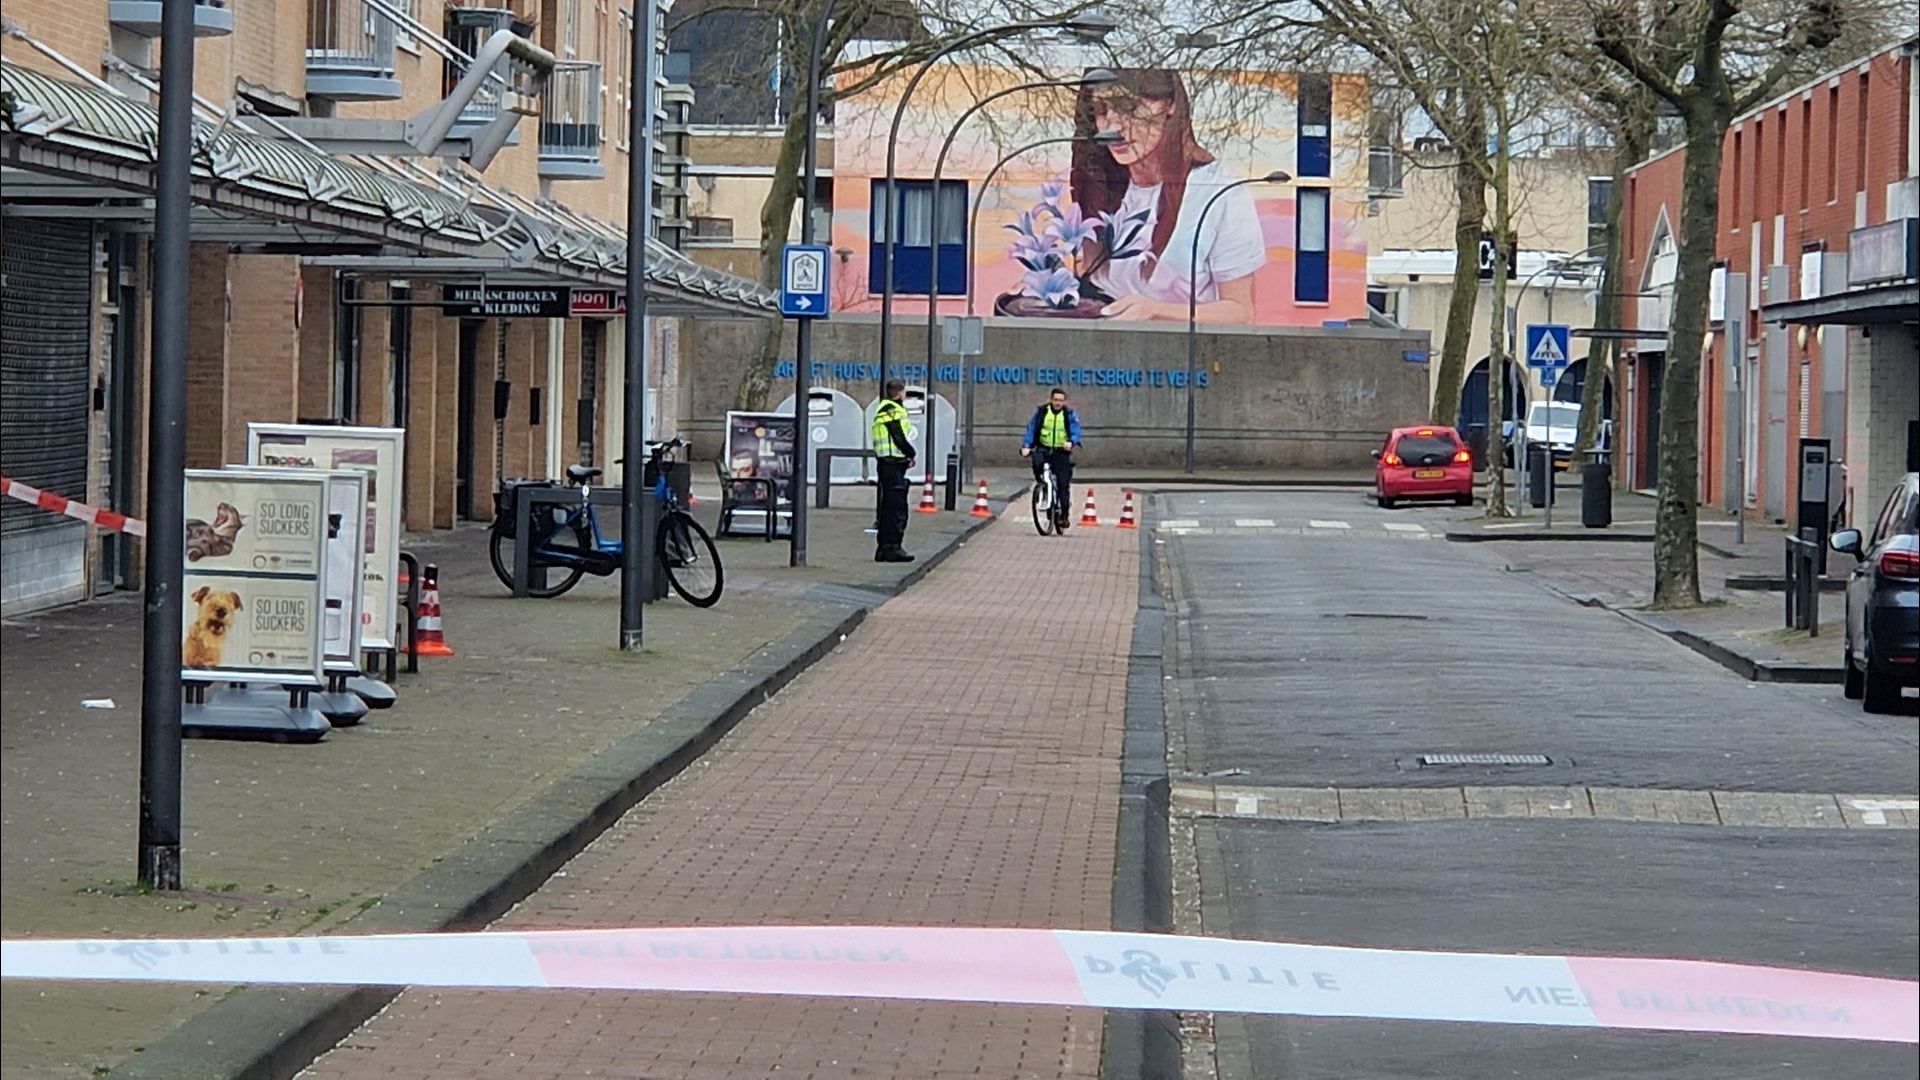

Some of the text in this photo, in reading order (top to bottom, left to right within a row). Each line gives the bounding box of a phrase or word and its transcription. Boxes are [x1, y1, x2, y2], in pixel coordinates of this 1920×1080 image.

[485, 303, 541, 315] KLEDING
[832, 361, 867, 382] HUIS
[870, 362, 902, 381] VN
[935, 364, 988, 384] VRIED
[1036, 366, 1065, 387] EEN
[260, 502, 309, 519] SO LONG
[259, 518, 309, 536] SUCKERS
[255, 598, 305, 616] SO LONG
[255, 615, 305, 632] SUCKERS
